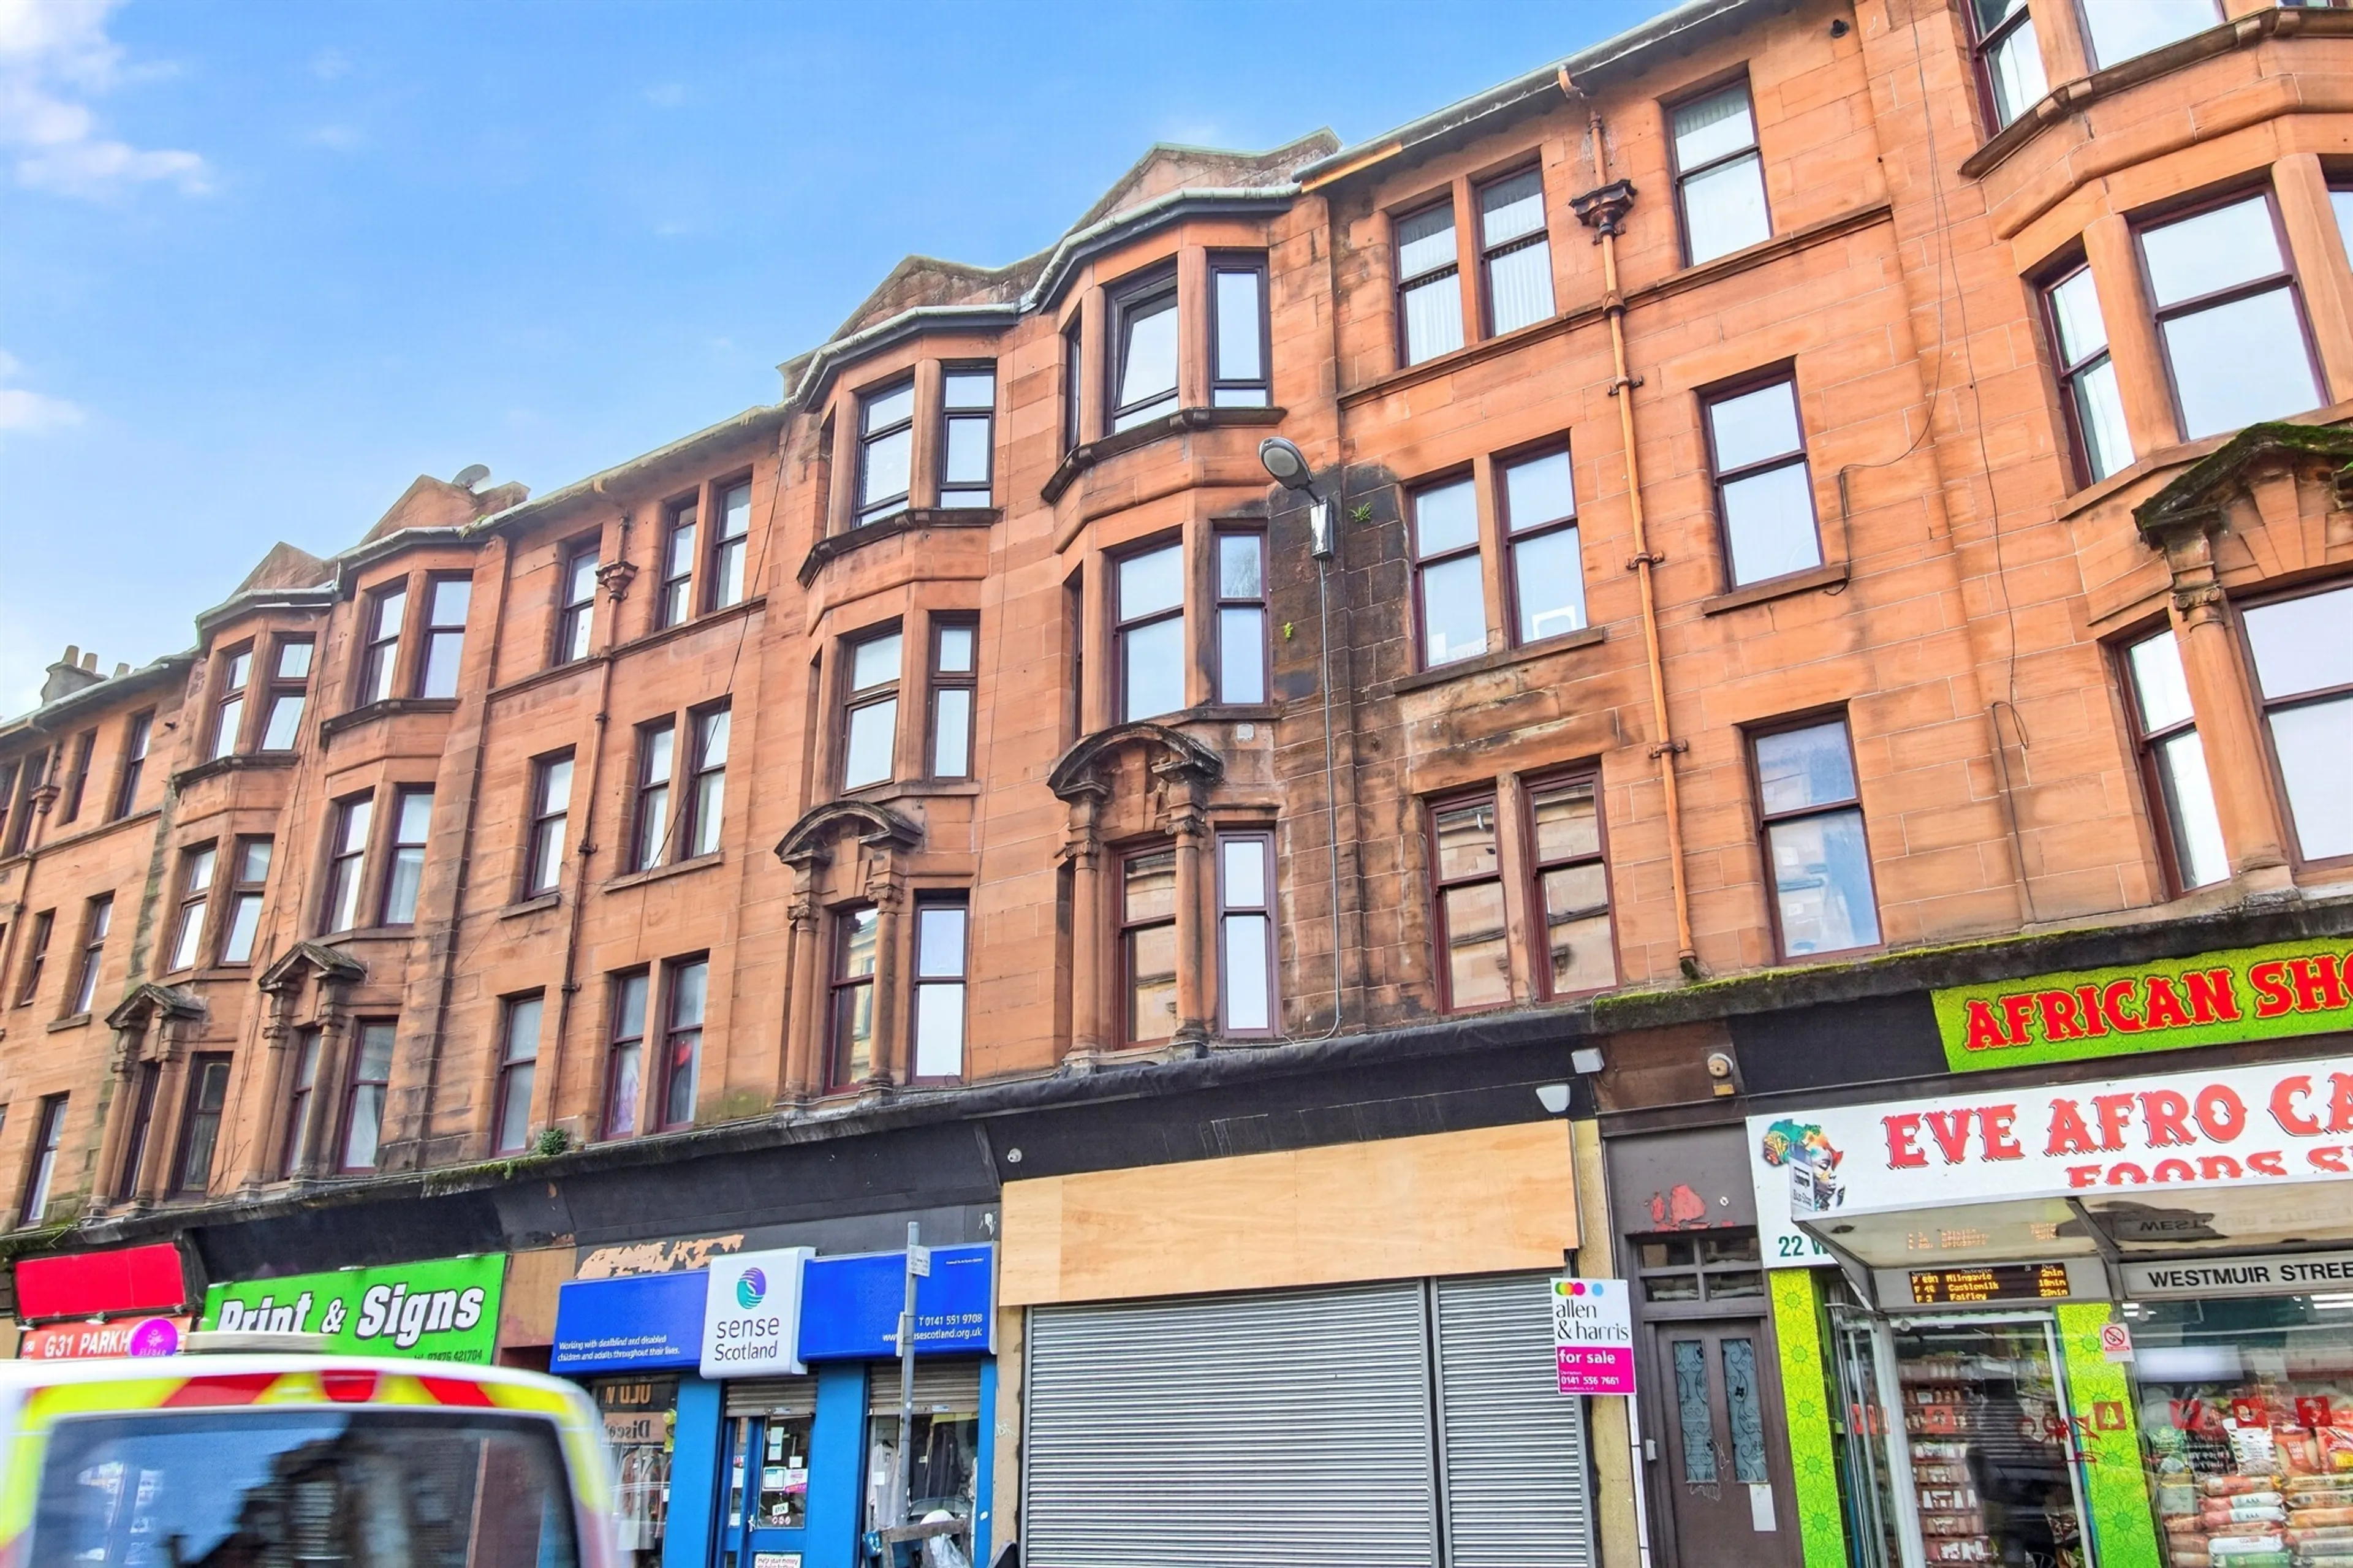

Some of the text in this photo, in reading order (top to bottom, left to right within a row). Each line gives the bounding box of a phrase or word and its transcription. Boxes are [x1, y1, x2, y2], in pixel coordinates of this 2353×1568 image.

[1965, 953, 2353, 1051] AFRICAN SH
[1880, 1104, 2025, 1170] EVE
[2042, 1083, 2248, 1157] AFRO
[1778, 1236, 1804, 1257] 22
[2148, 1266, 2270, 1287] WESTMUIR
[216, 1281, 485, 1348] Print & Signs
[1556, 1299, 1597, 1318] allen
[716, 1317, 779, 1339] sense
[919, 1314, 982, 1327] T 0141 551 9708
[1558, 1320, 1629, 1341] & harris
[45, 1333, 75, 1357] G31
[628, 1336, 640, 1346] and
[714, 1340, 778, 1361] Scotland
[582, 1351, 593, 1360] and
[1559, 1349, 1616, 1364] for sale
